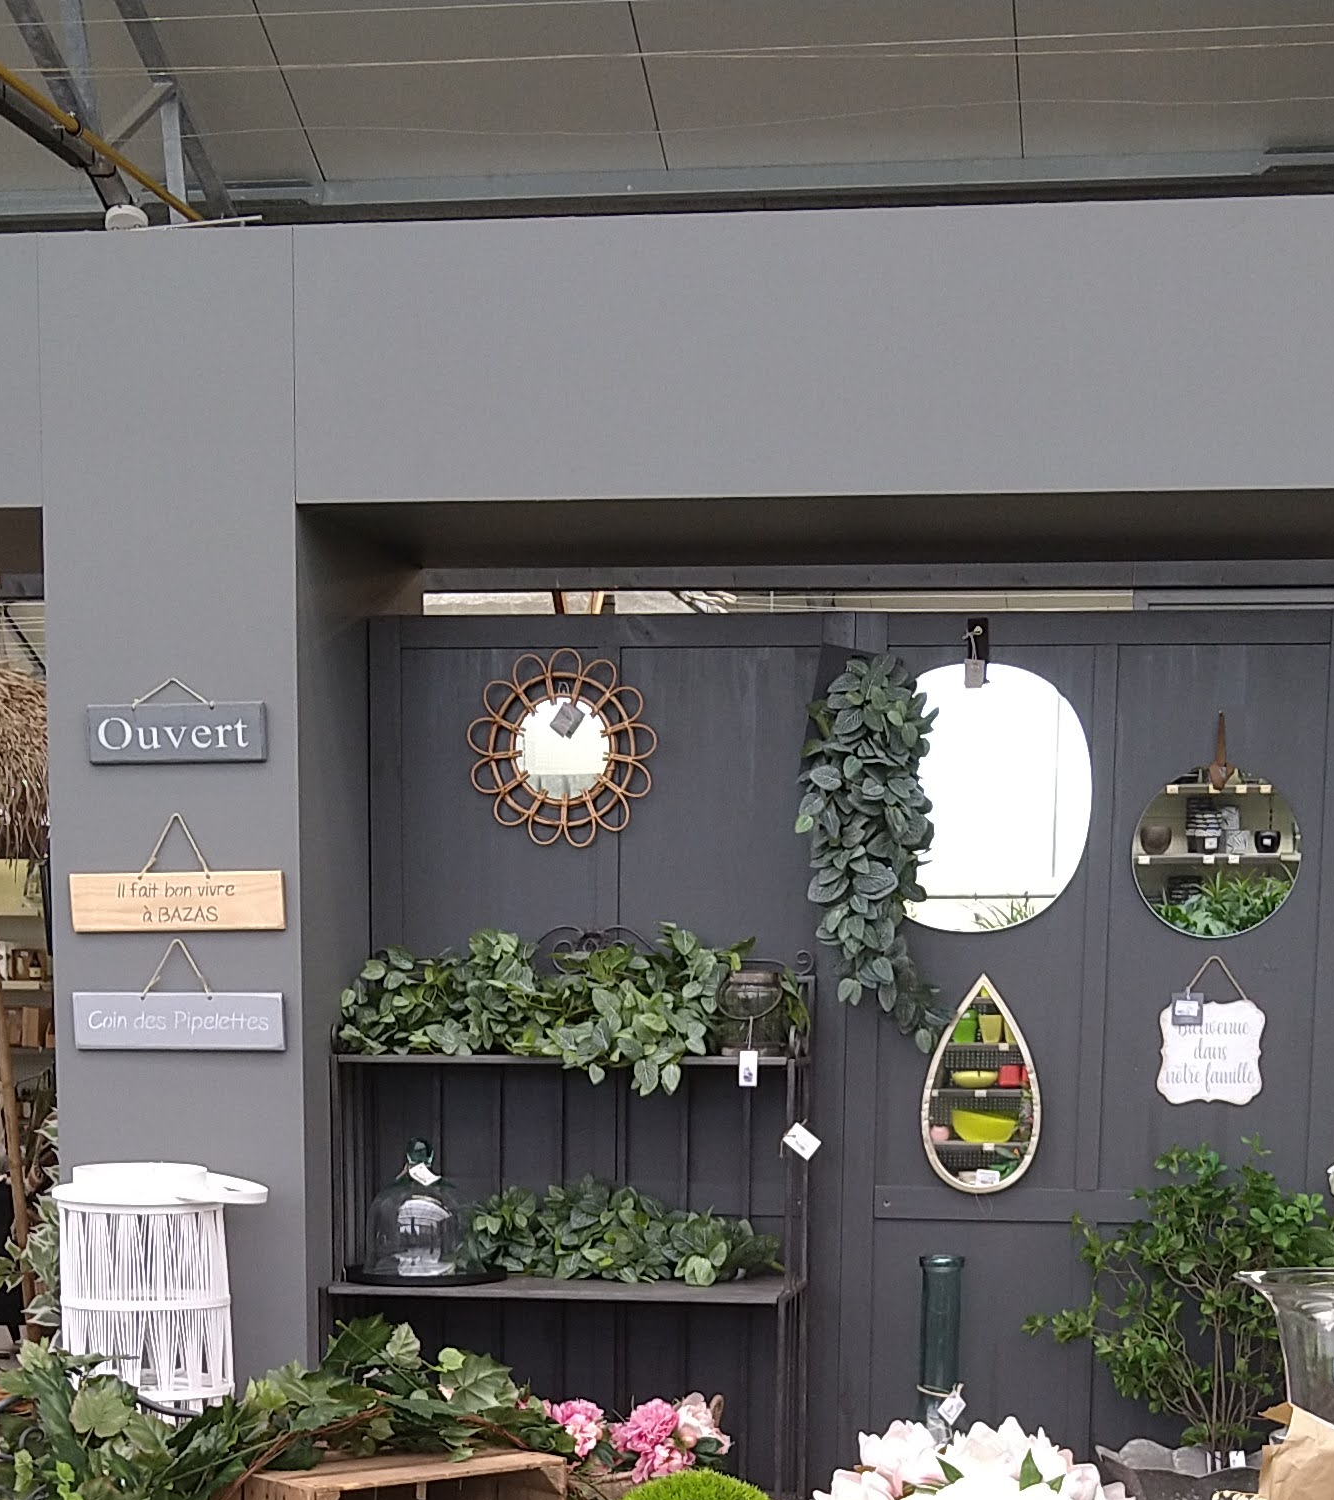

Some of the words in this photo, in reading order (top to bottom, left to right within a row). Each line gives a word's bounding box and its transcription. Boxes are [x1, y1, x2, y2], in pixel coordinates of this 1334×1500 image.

[97, 716, 249, 750] Ouvert
[116, 882, 126, 899] Il
[130, 881, 158, 899] fait
[164, 880, 192, 898] bon
[197, 881, 236, 898] vivre
[142, 906, 153, 923] à
[158, 906, 219, 923] BAZAS
[88, 1010, 127, 1030] Coin
[133, 1010, 166, 1030] des
[174, 1009, 269, 1035] Pipelettes
[1193, 1037, 1227, 1060] dans
[1165, 1062, 1201, 1084] notre
[1205, 1061, 1254, 1093] famille
